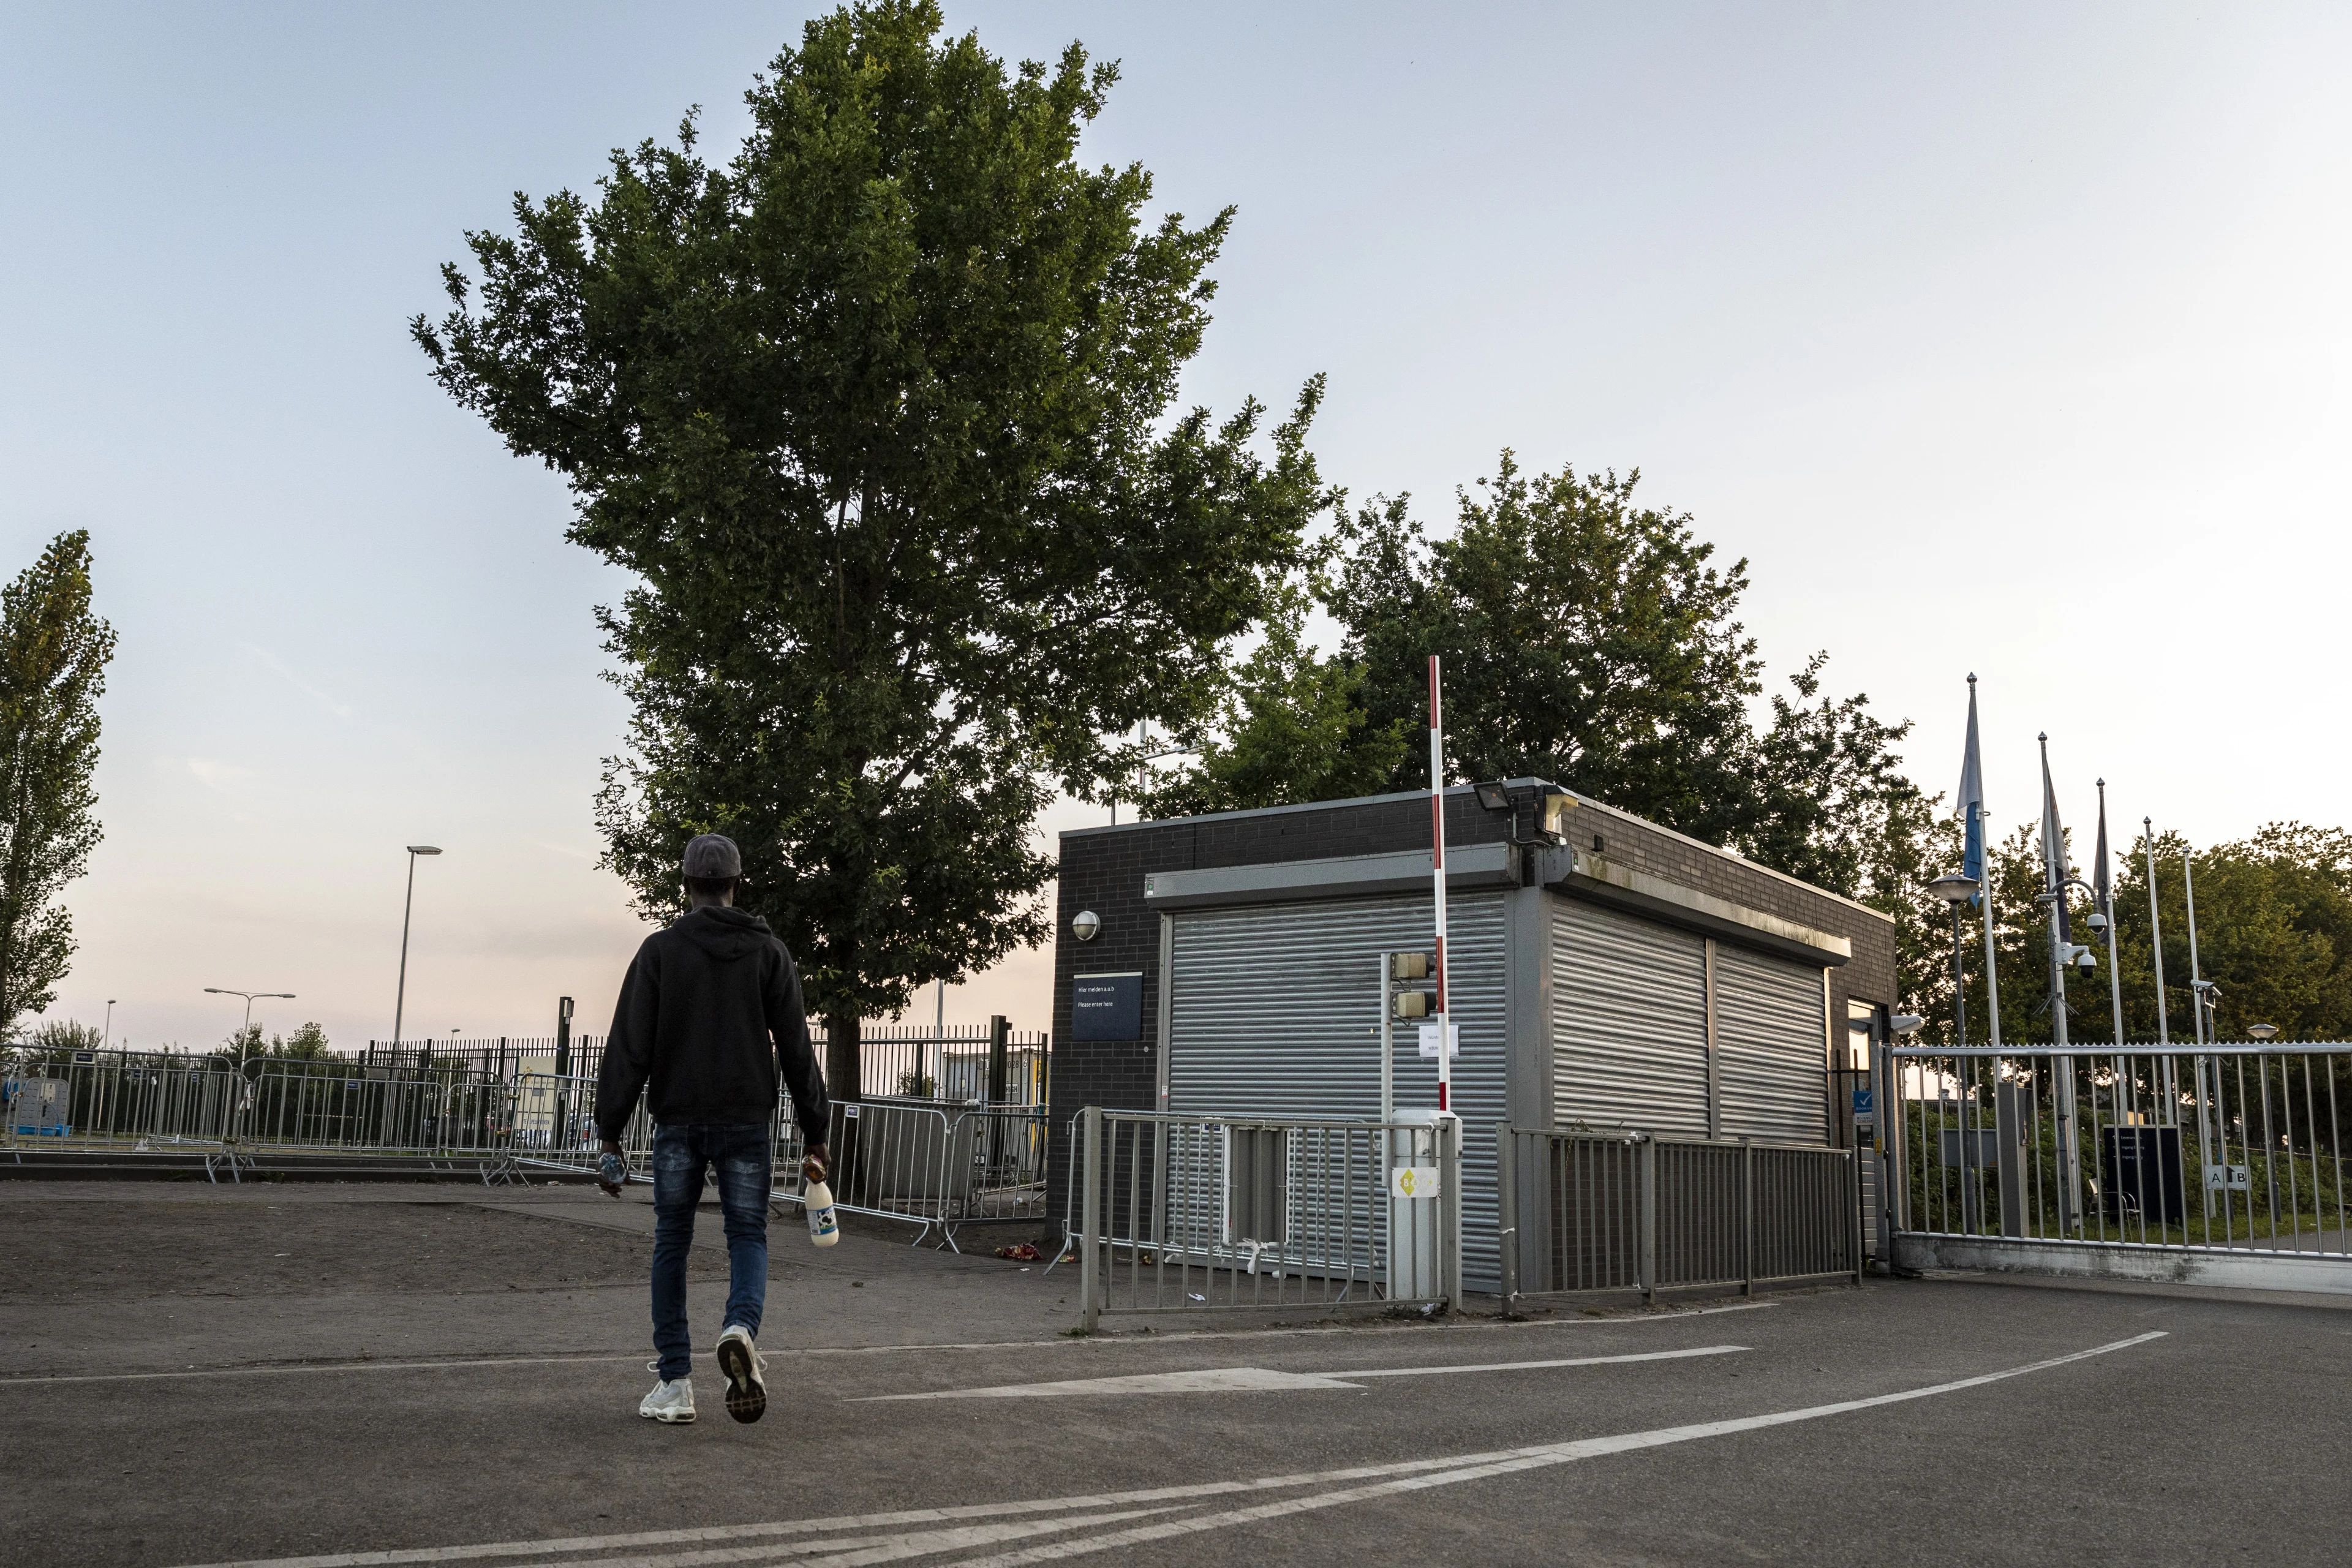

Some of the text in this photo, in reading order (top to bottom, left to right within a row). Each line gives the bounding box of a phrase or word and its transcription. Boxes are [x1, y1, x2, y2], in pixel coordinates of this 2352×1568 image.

[1403, 1178, 1409, 1187] B
[2212, 1172, 2245, 1183] A B
